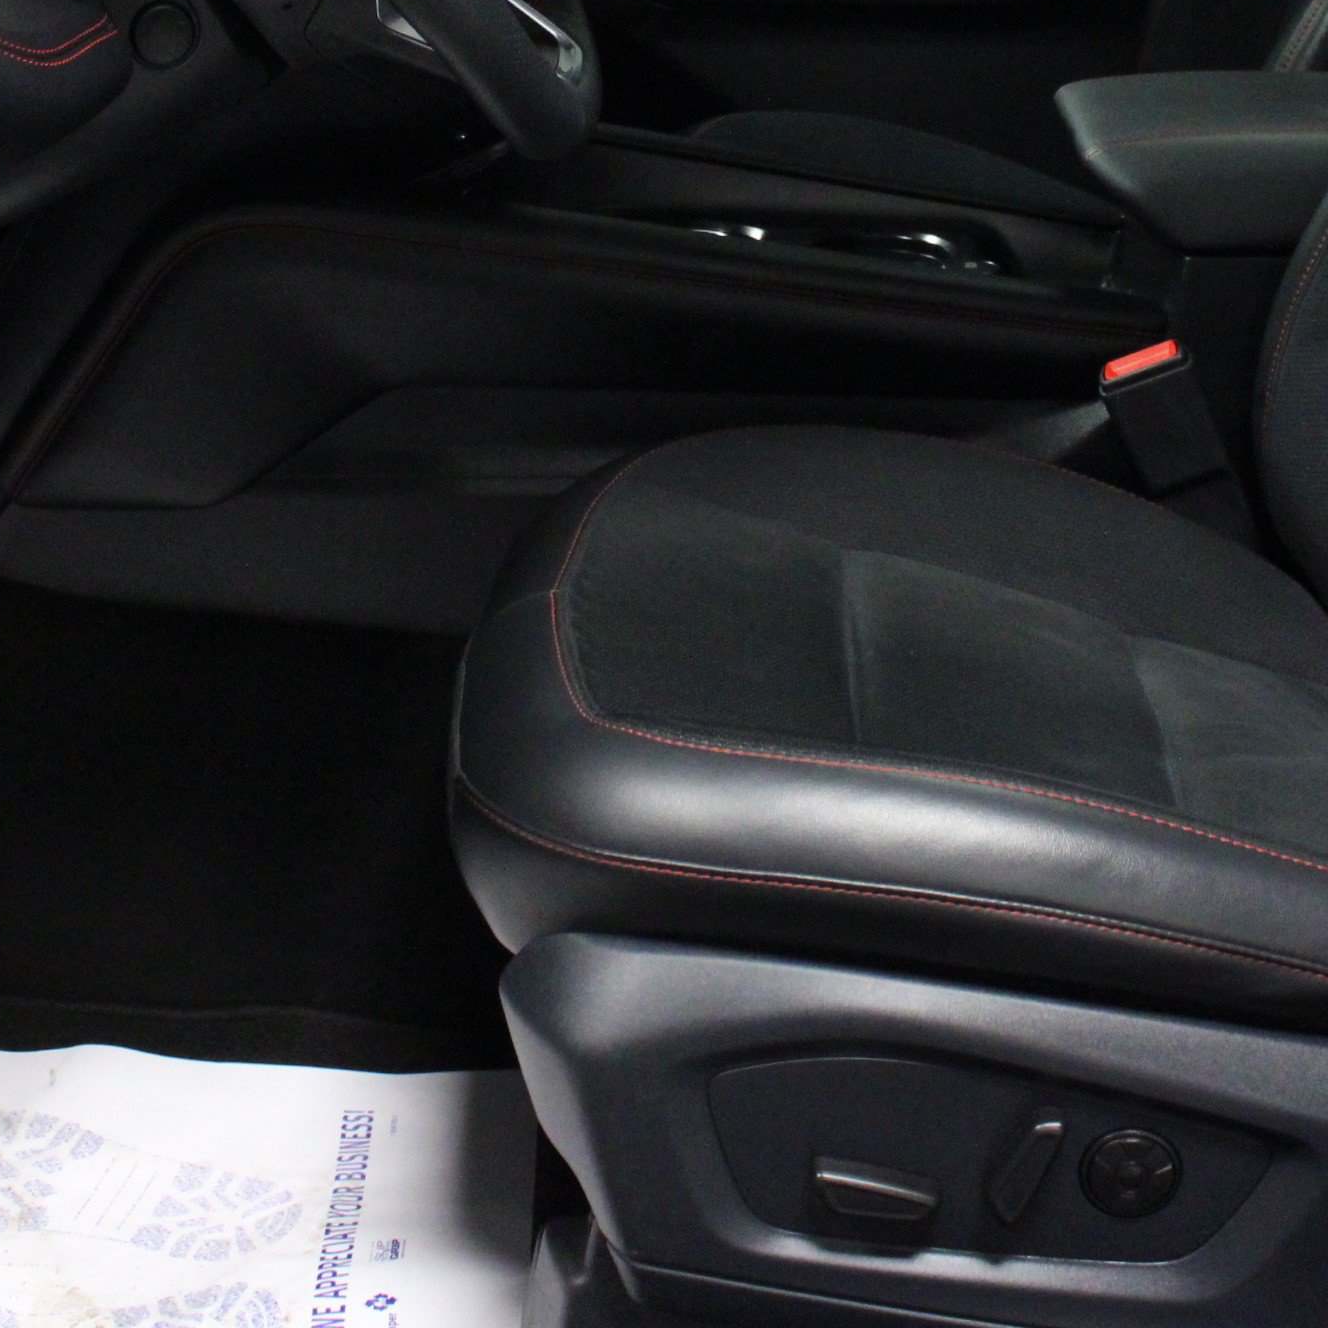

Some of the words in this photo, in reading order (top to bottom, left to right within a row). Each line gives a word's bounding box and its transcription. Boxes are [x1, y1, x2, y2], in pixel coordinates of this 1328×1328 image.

[335, 1109, 375, 1182] BUSINESS!
[327, 1185, 365, 1221] YOUR
[313, 1220, 359, 1299] APPRECIATE
